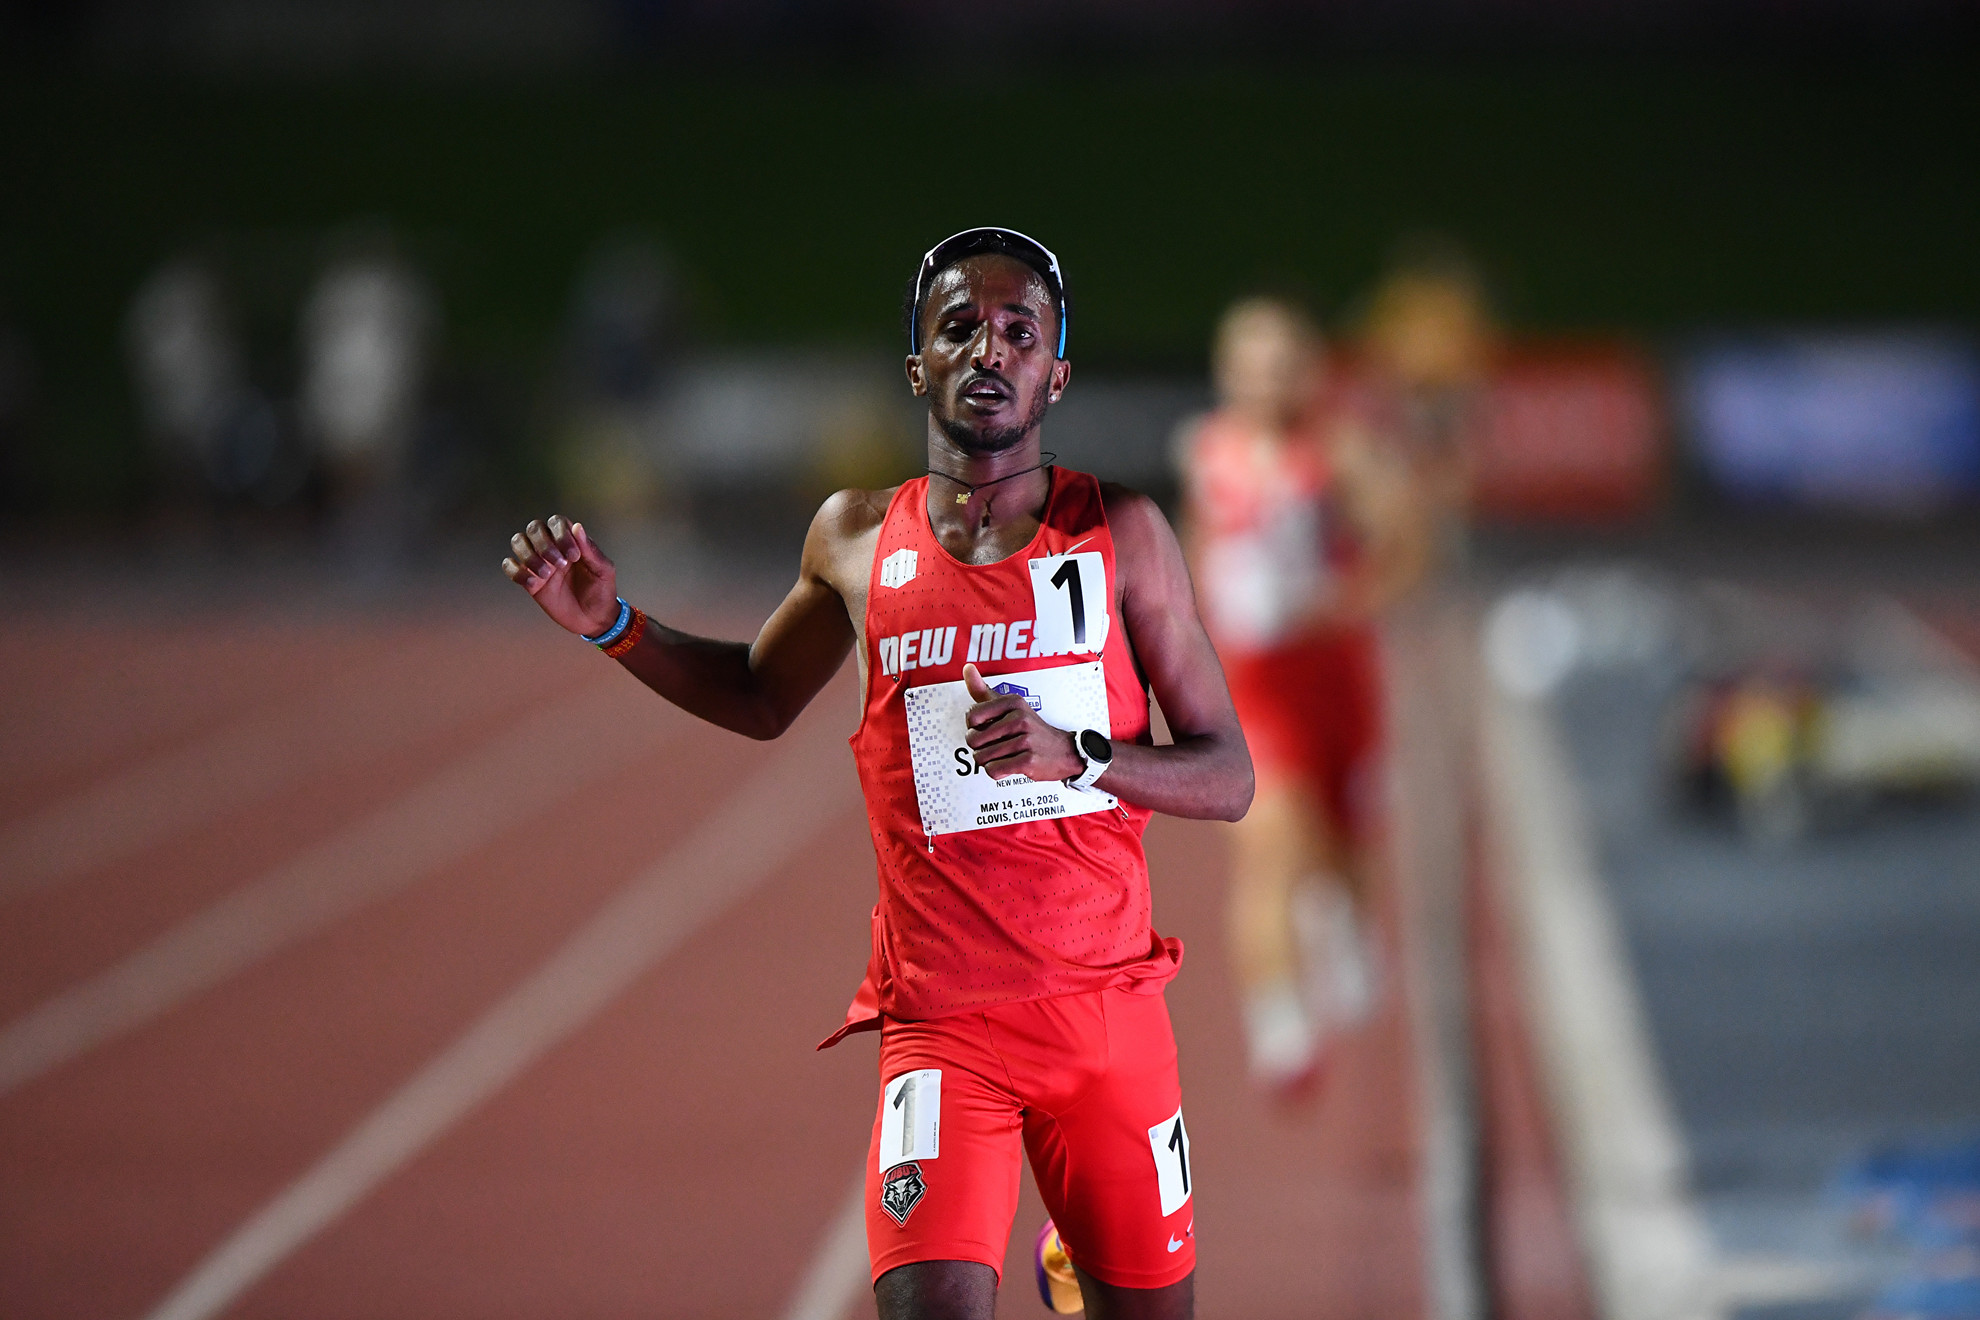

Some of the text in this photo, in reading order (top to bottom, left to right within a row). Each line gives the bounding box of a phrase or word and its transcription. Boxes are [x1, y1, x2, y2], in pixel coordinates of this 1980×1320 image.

[1050, 559, 1086, 644] 1
[879, 626, 958, 676] NEW
[996, 780, 1011, 788] NEW
[976, 805, 1066, 825] CLOVIS, CALIFORNIA
[980, 802, 1000, 813] MAY
[1002, 800, 1013, 810] 14
[1021, 797, 1035, 807] 16,
[1037, 794, 1059, 805] 2026
[893, 1076, 917, 1157] 1
[1168, 1116, 1189, 1196] 1
[886, 1165, 918, 1184] LOBOS
